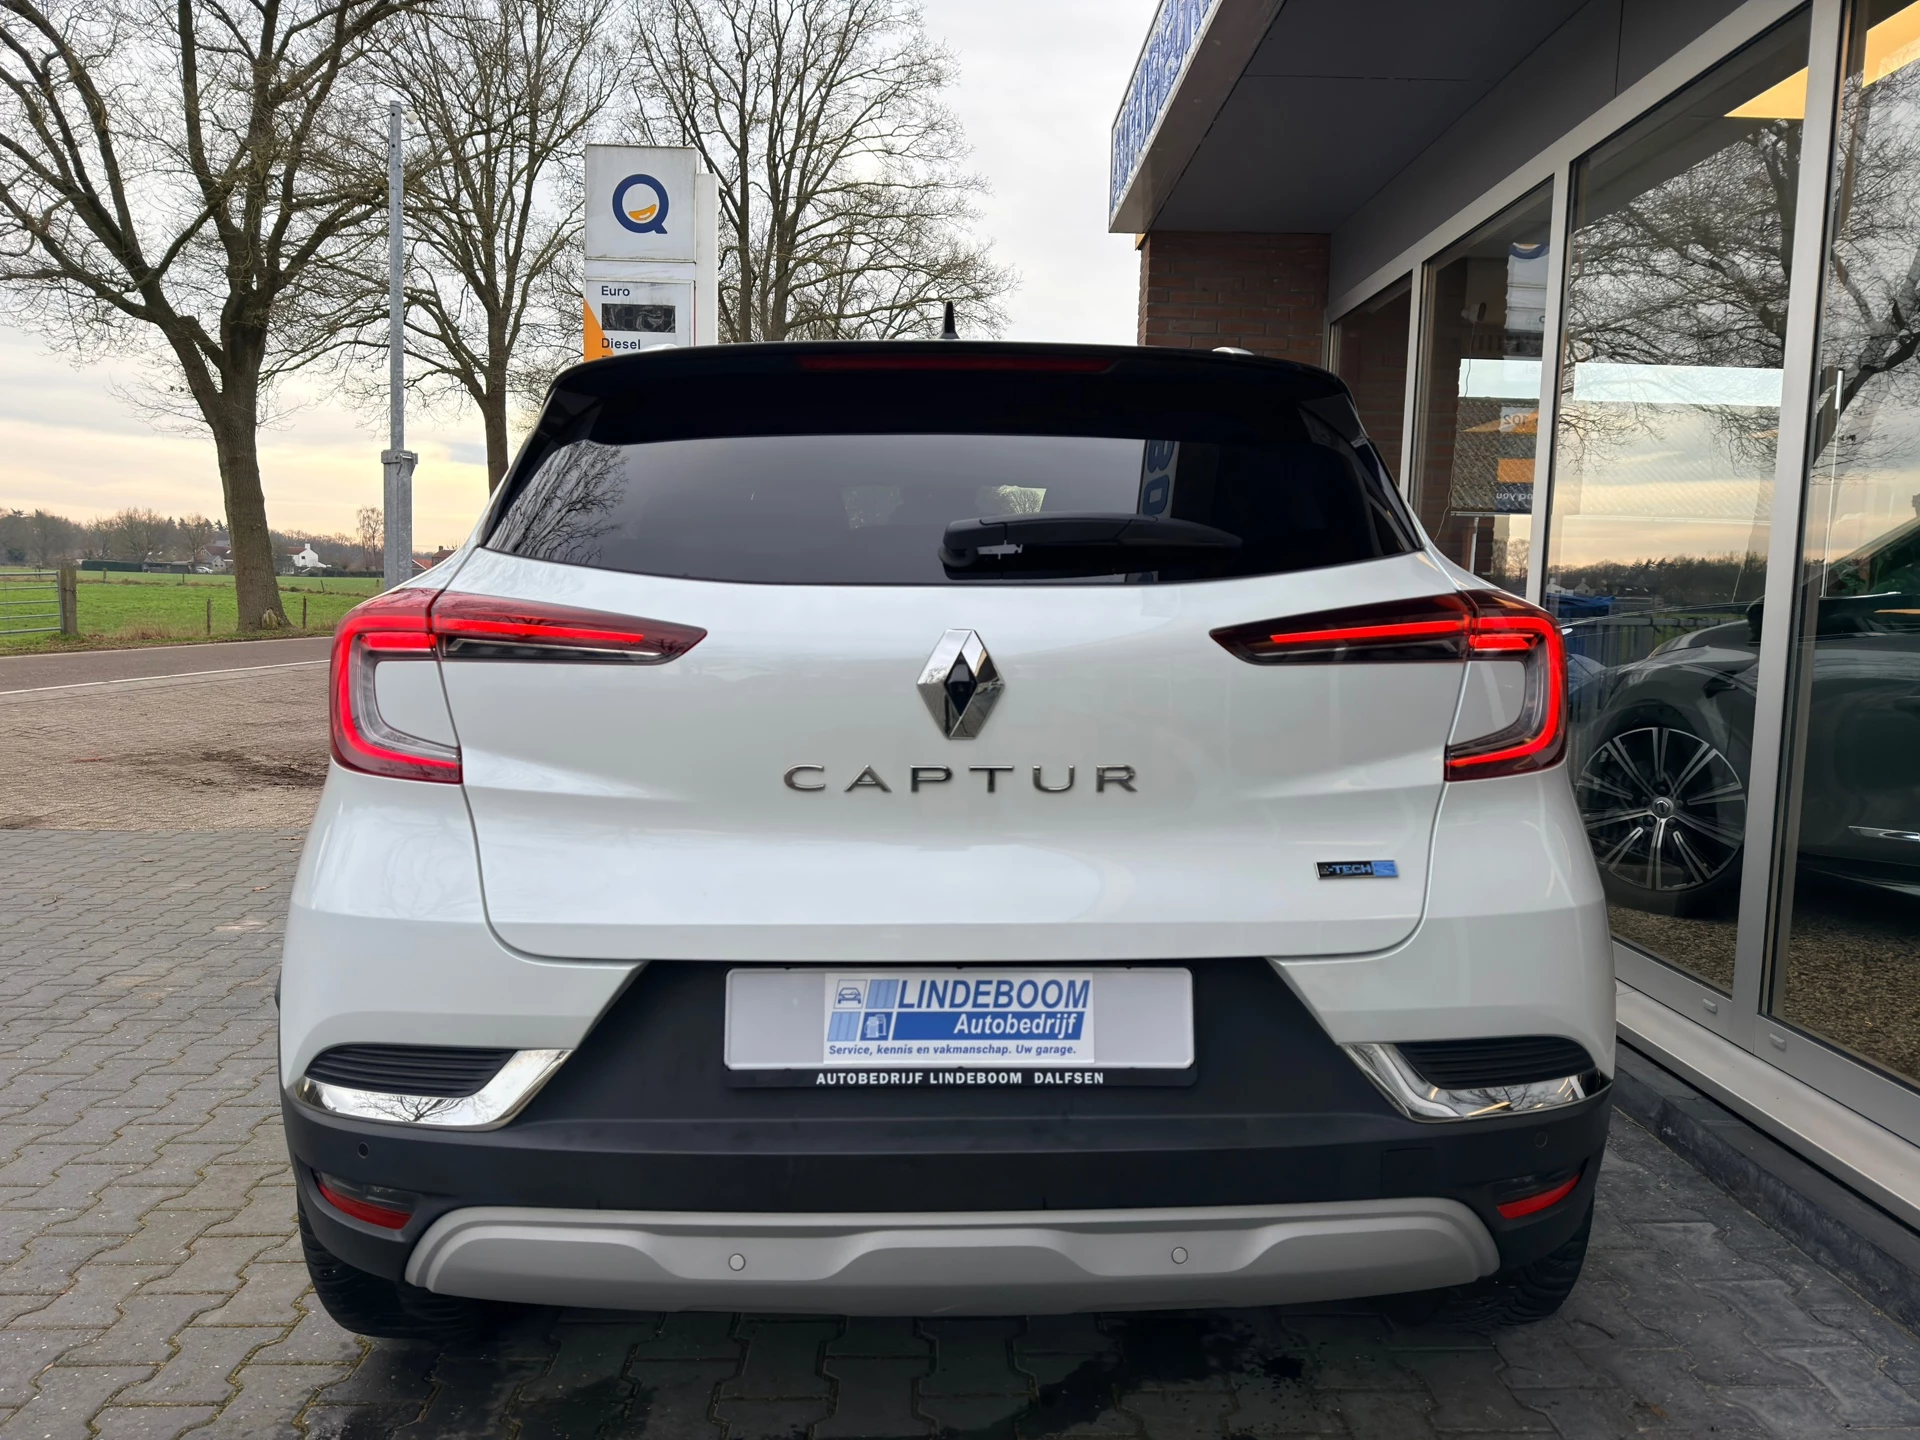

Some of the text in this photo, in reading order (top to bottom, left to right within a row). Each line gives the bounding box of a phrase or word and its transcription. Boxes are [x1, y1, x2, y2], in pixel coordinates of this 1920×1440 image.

[612, 173, 669, 234] Q
[601, 286, 630, 297] Euro
[601, 338, 641, 350] Diesel
[783, 764, 1138, 793] CAPTUR
[898, 979, 1091, 1009] LINDEBOOM
[953, 1013, 1077, 1039] Autobedrijf
[829, 1044, 1077, 1056] Service, kennis en vakmanschap. Uw garage.
[816, 1072, 1104, 1085] AUTOBEDRIJF LINDEBOOM DALFSEN
